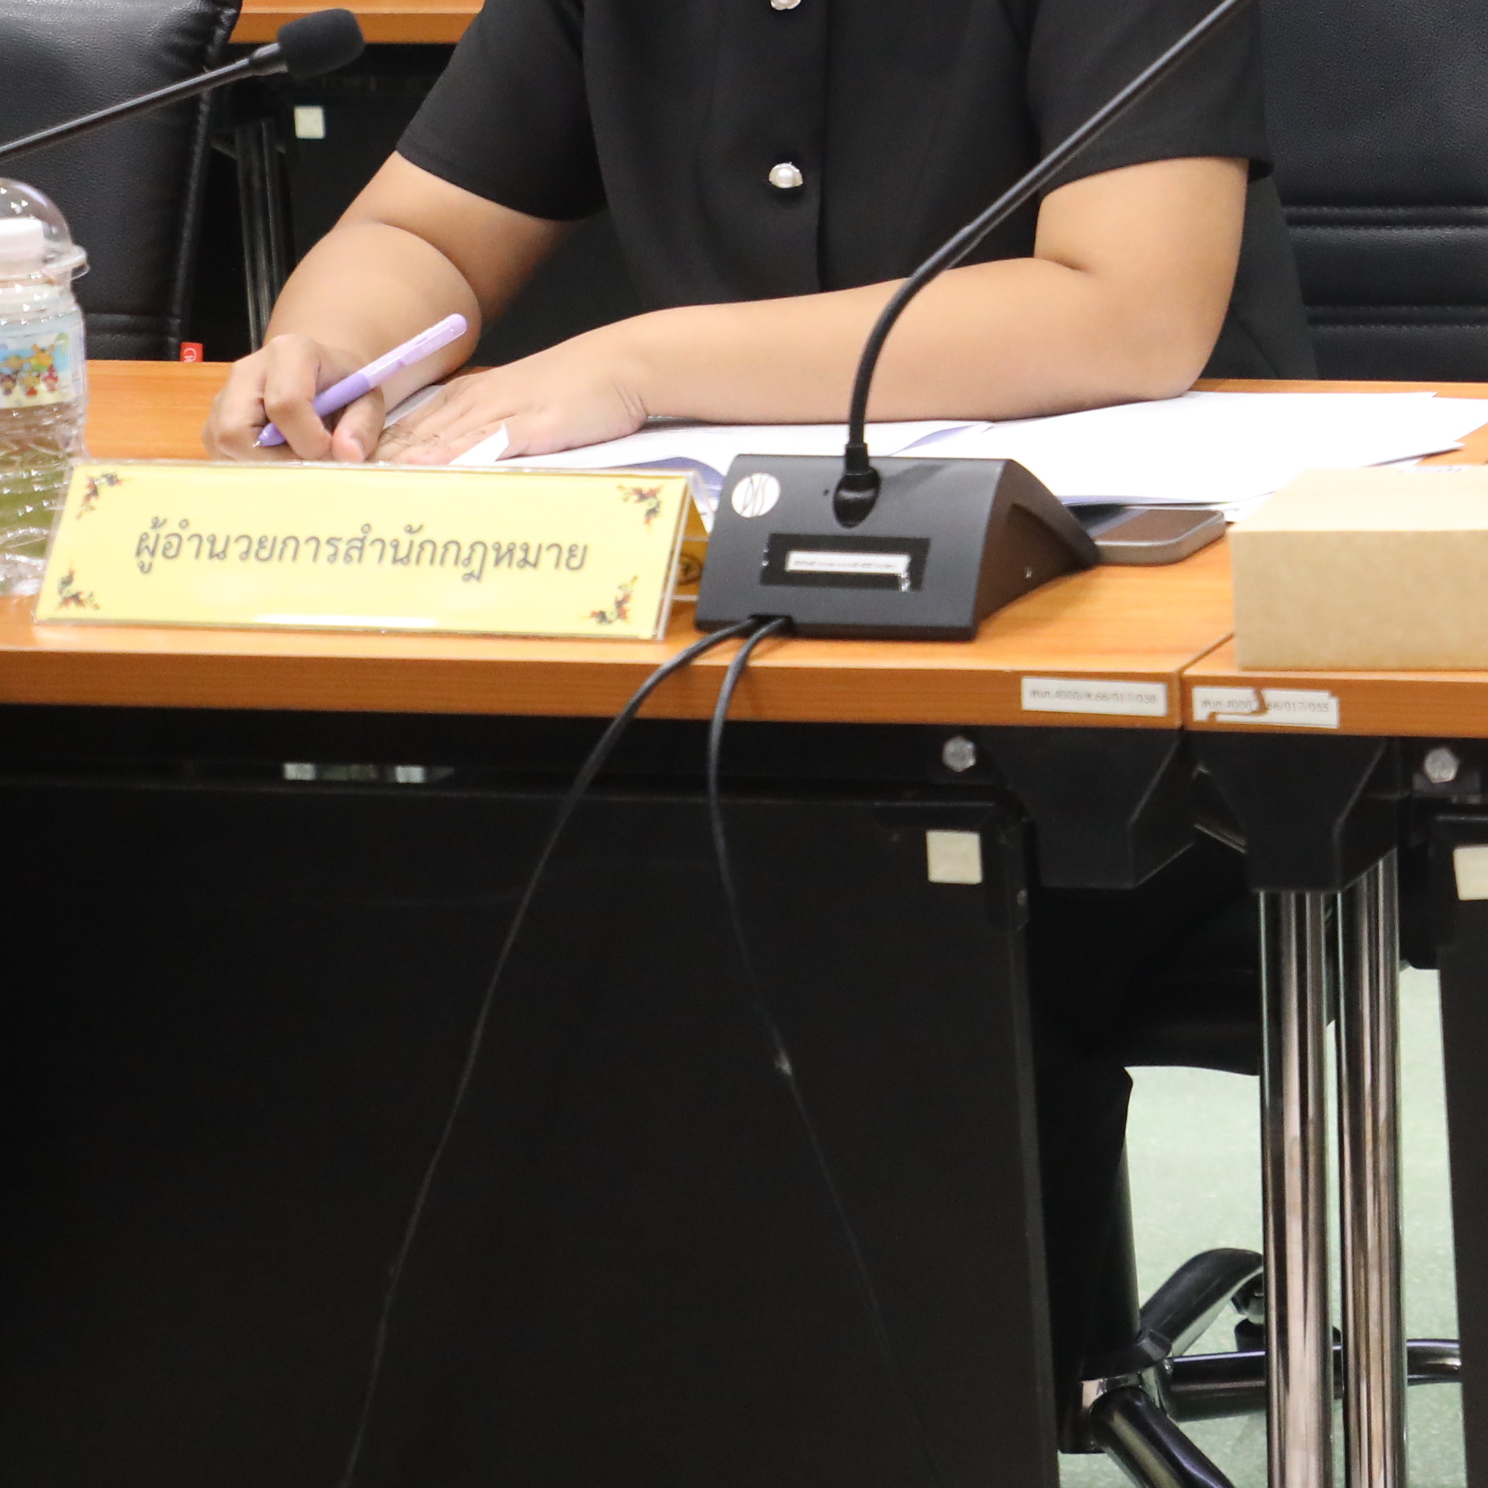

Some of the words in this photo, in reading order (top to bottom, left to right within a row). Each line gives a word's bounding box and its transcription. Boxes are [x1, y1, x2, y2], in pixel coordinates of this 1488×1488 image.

[134, 516, 588, 583] ผู้อำนวยการสำนักกฎหมาย
